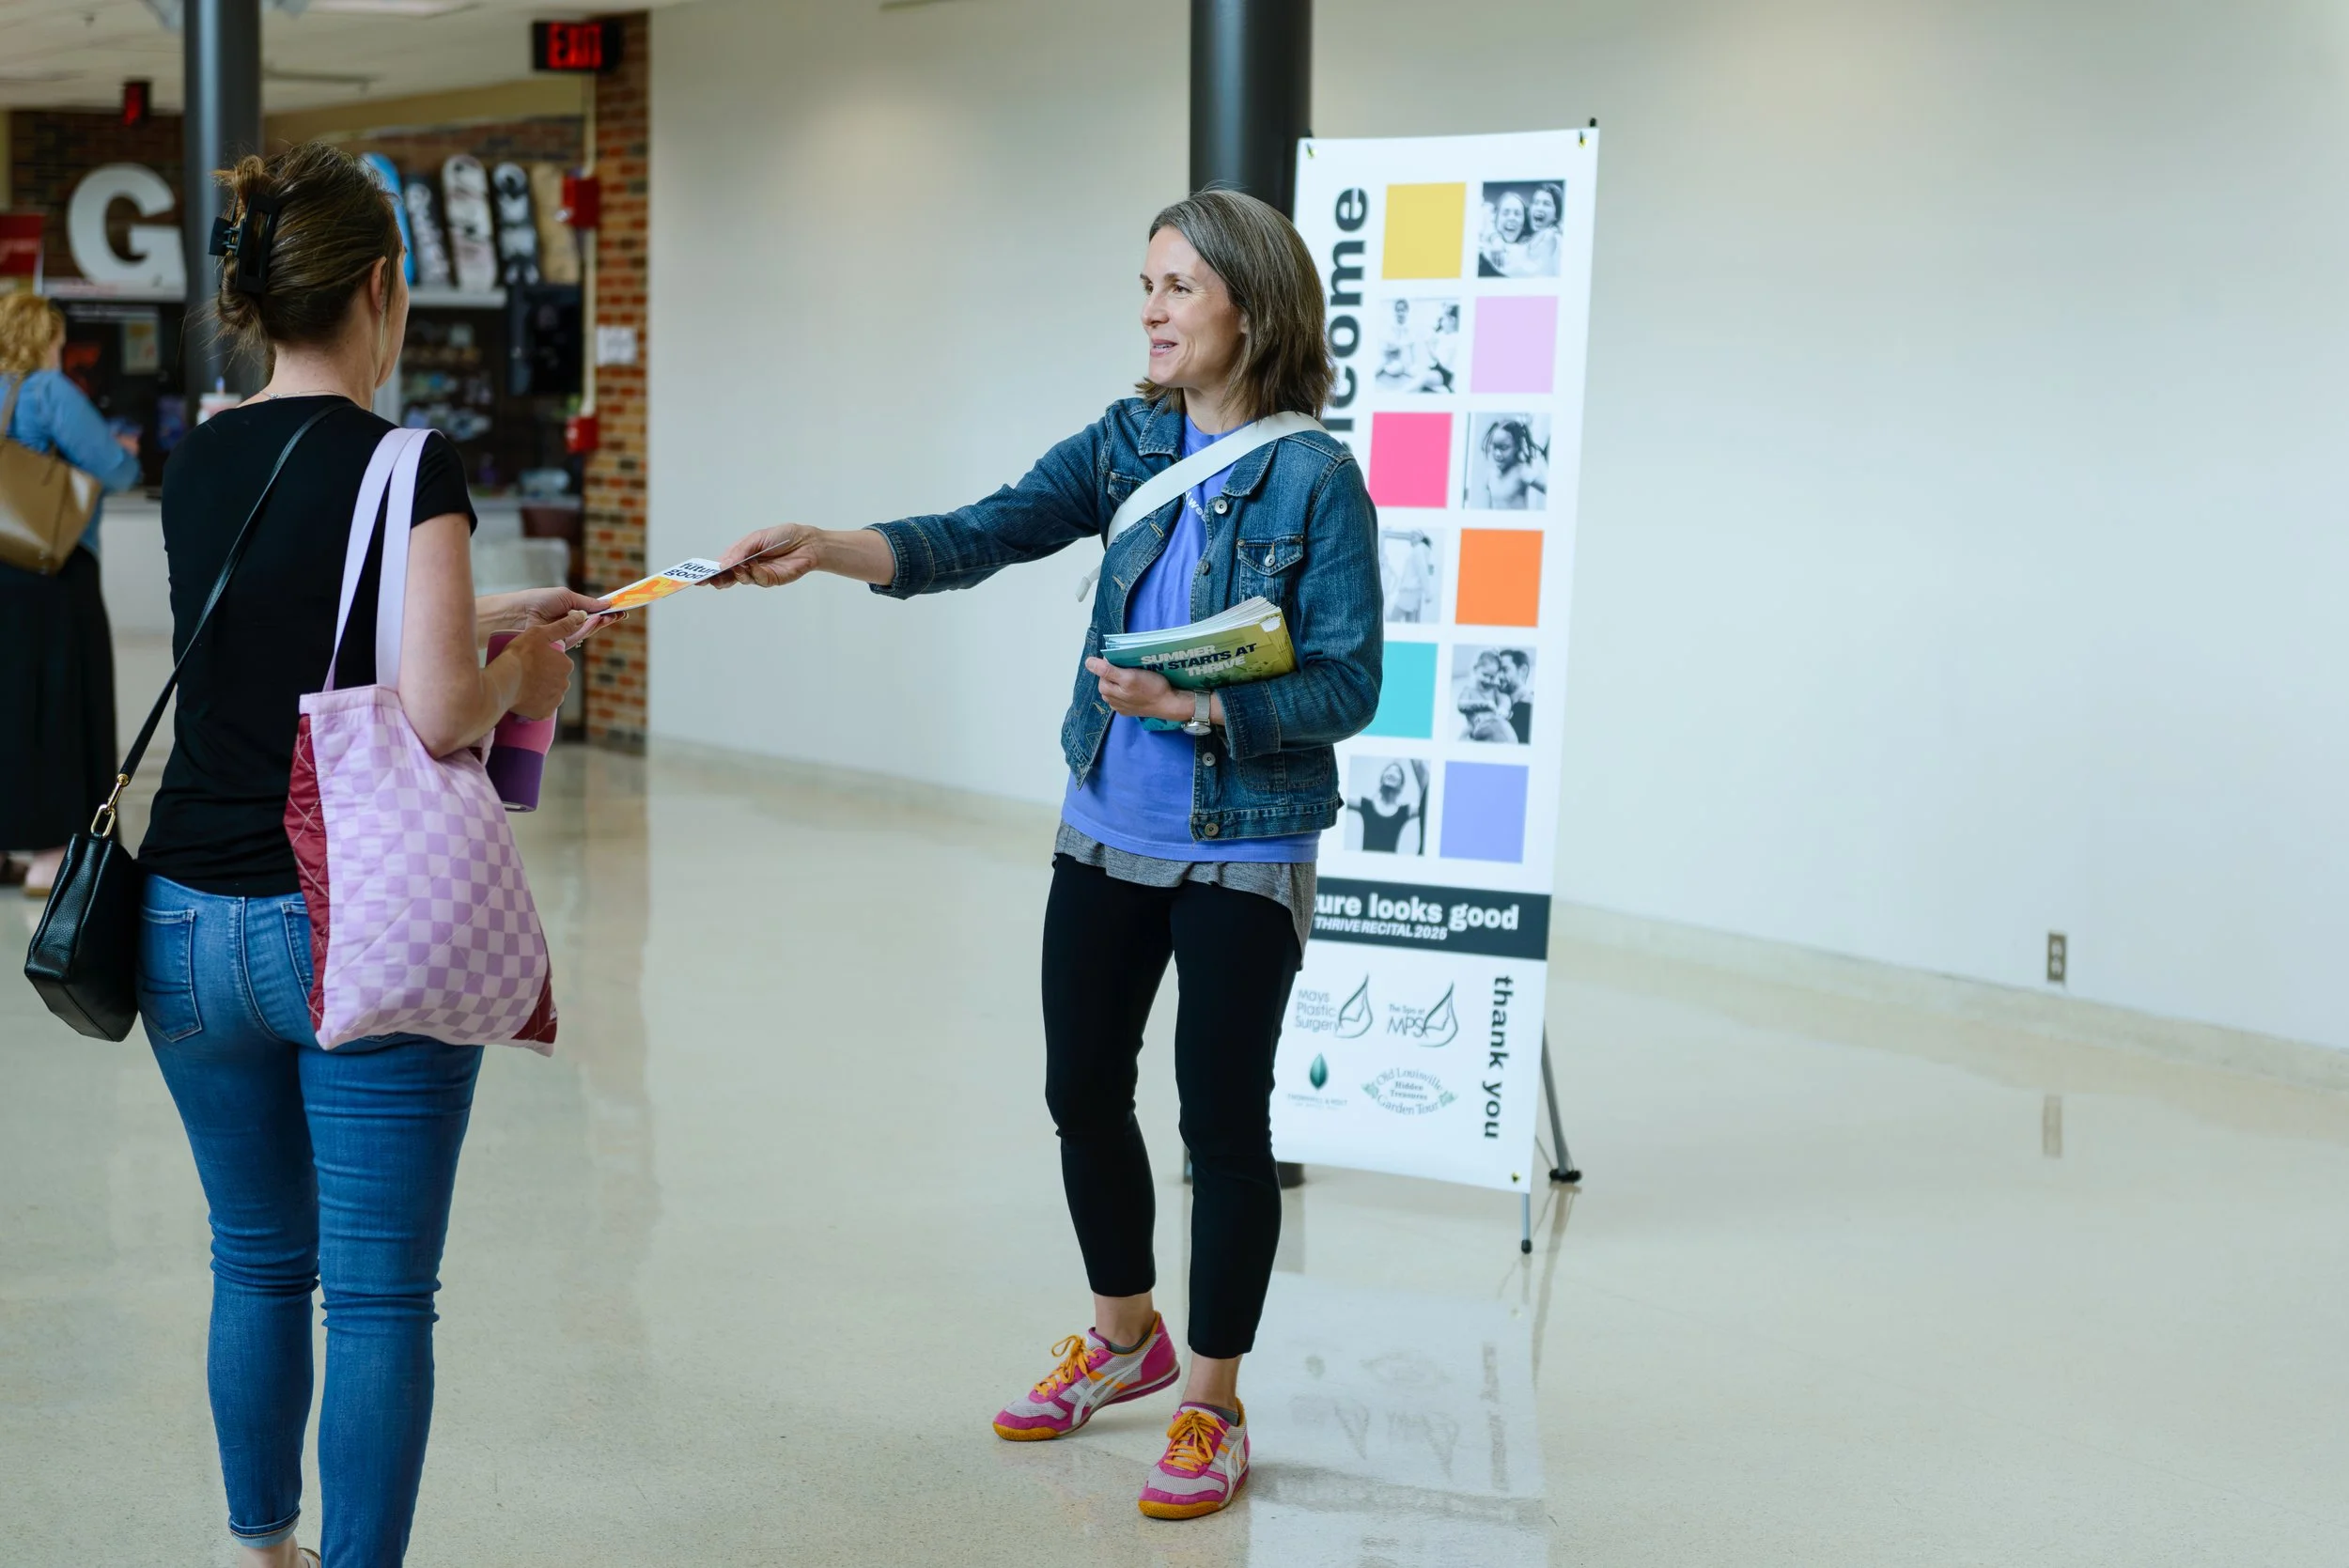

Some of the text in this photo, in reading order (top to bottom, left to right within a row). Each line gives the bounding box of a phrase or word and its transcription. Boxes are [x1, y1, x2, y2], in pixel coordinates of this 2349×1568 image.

[548, 21, 602, 69] EXIT
[67, 163, 186, 287] G
[1141, 644, 1216, 665] SUMMER
[1168, 650, 1232, 670] STARTS
[1236, 643, 1257, 657] AT
[1186, 655, 1246, 676] THRIVE
[1368, 893, 1443, 924] looks
[1448, 903, 1520, 933] good
[1314, 916, 1362, 934] THRIVE
[1361, 920, 1413, 938] RECITAL
[1296, 1001, 1337, 1018] Plastic
[1295, 1015, 1343, 1033] Surgery
[1482, 975, 1514, 1140] thank you
[1394, 1081, 1424, 1091] Hidden
